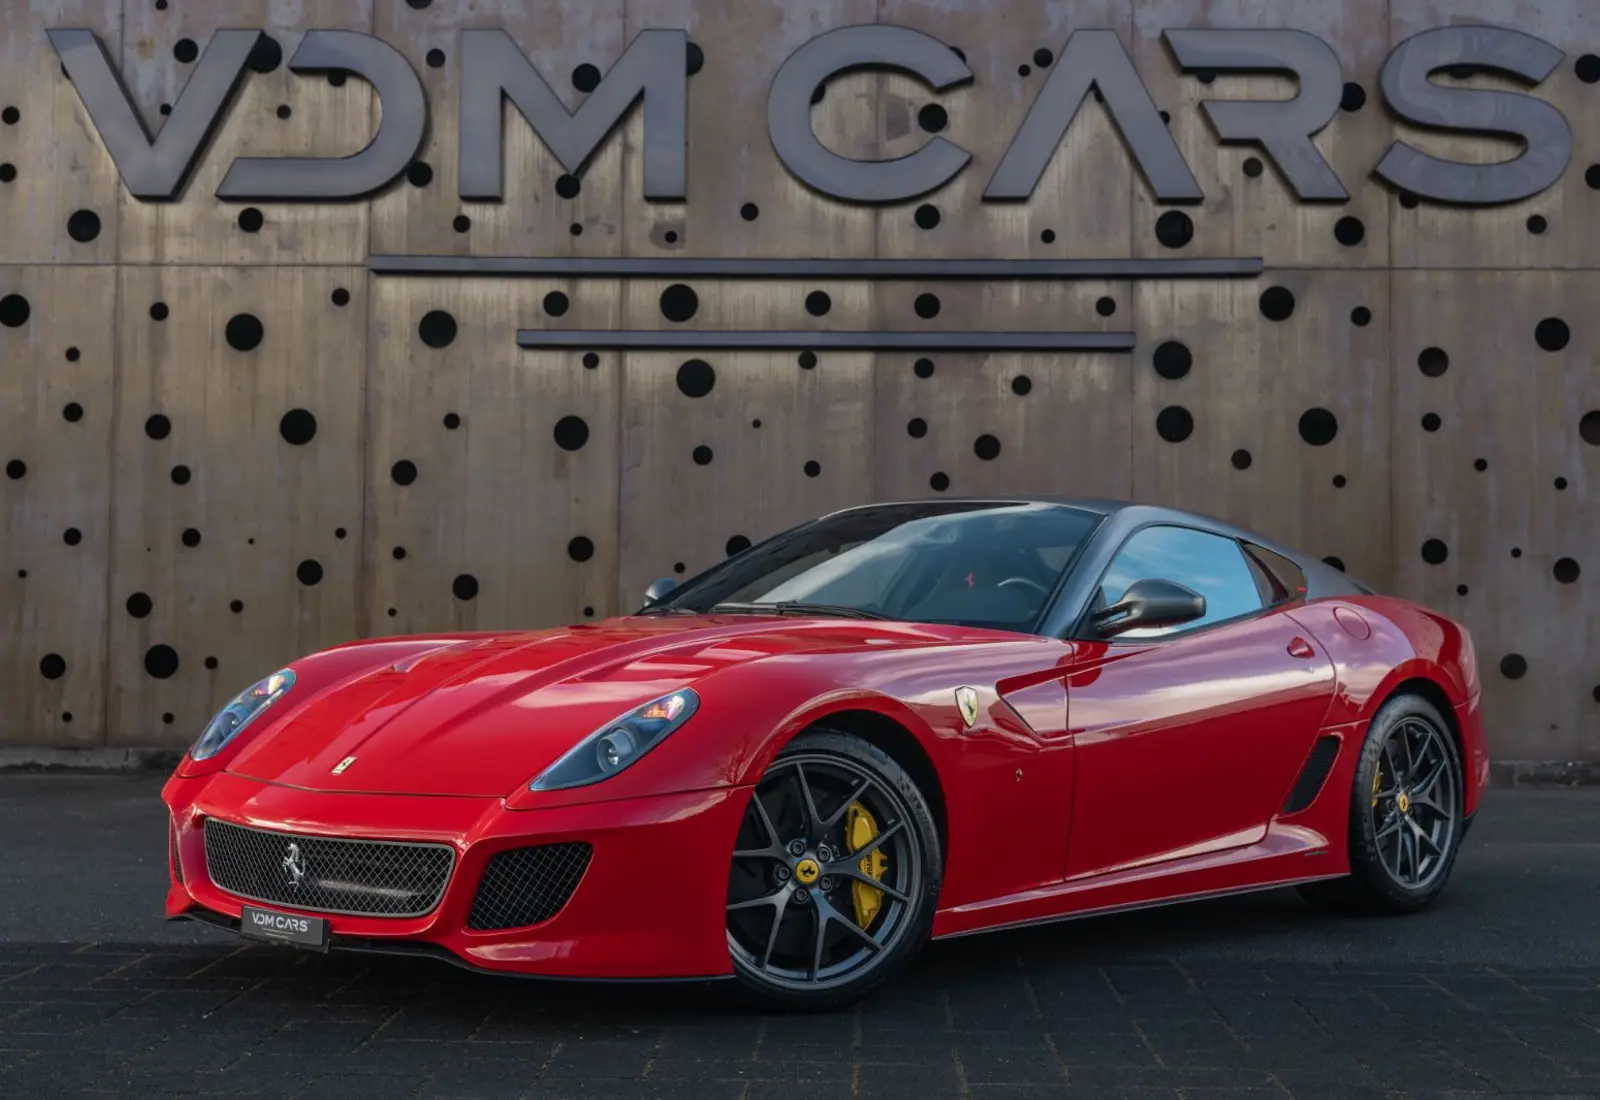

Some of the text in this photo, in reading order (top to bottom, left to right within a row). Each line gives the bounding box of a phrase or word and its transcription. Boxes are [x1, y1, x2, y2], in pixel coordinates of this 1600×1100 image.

[46, 25, 1574, 206] VDM CARS
[252, 912, 274, 927] VDM
